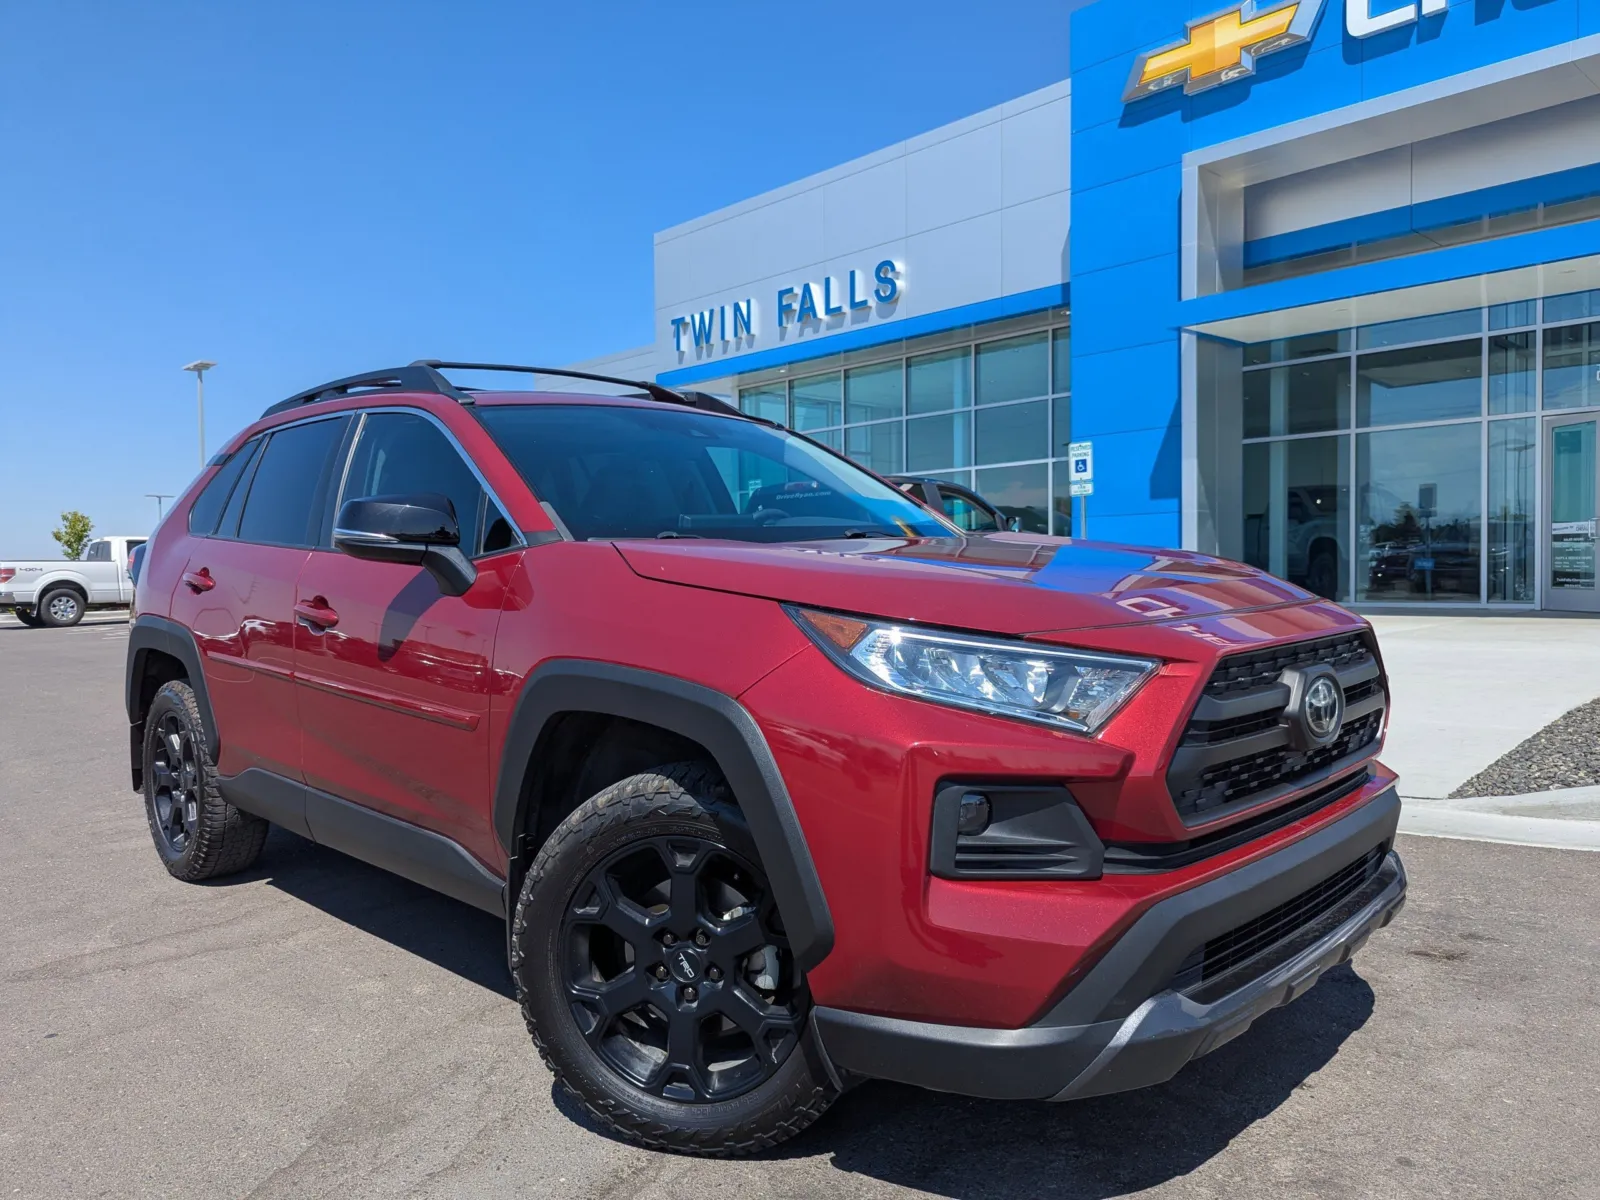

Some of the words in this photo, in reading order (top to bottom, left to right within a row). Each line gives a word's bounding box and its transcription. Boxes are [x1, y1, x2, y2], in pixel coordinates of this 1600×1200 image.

[671, 299, 753, 352] TWIN
[777, 259, 900, 329] FALLS
[678, 952, 695, 978] TRD
